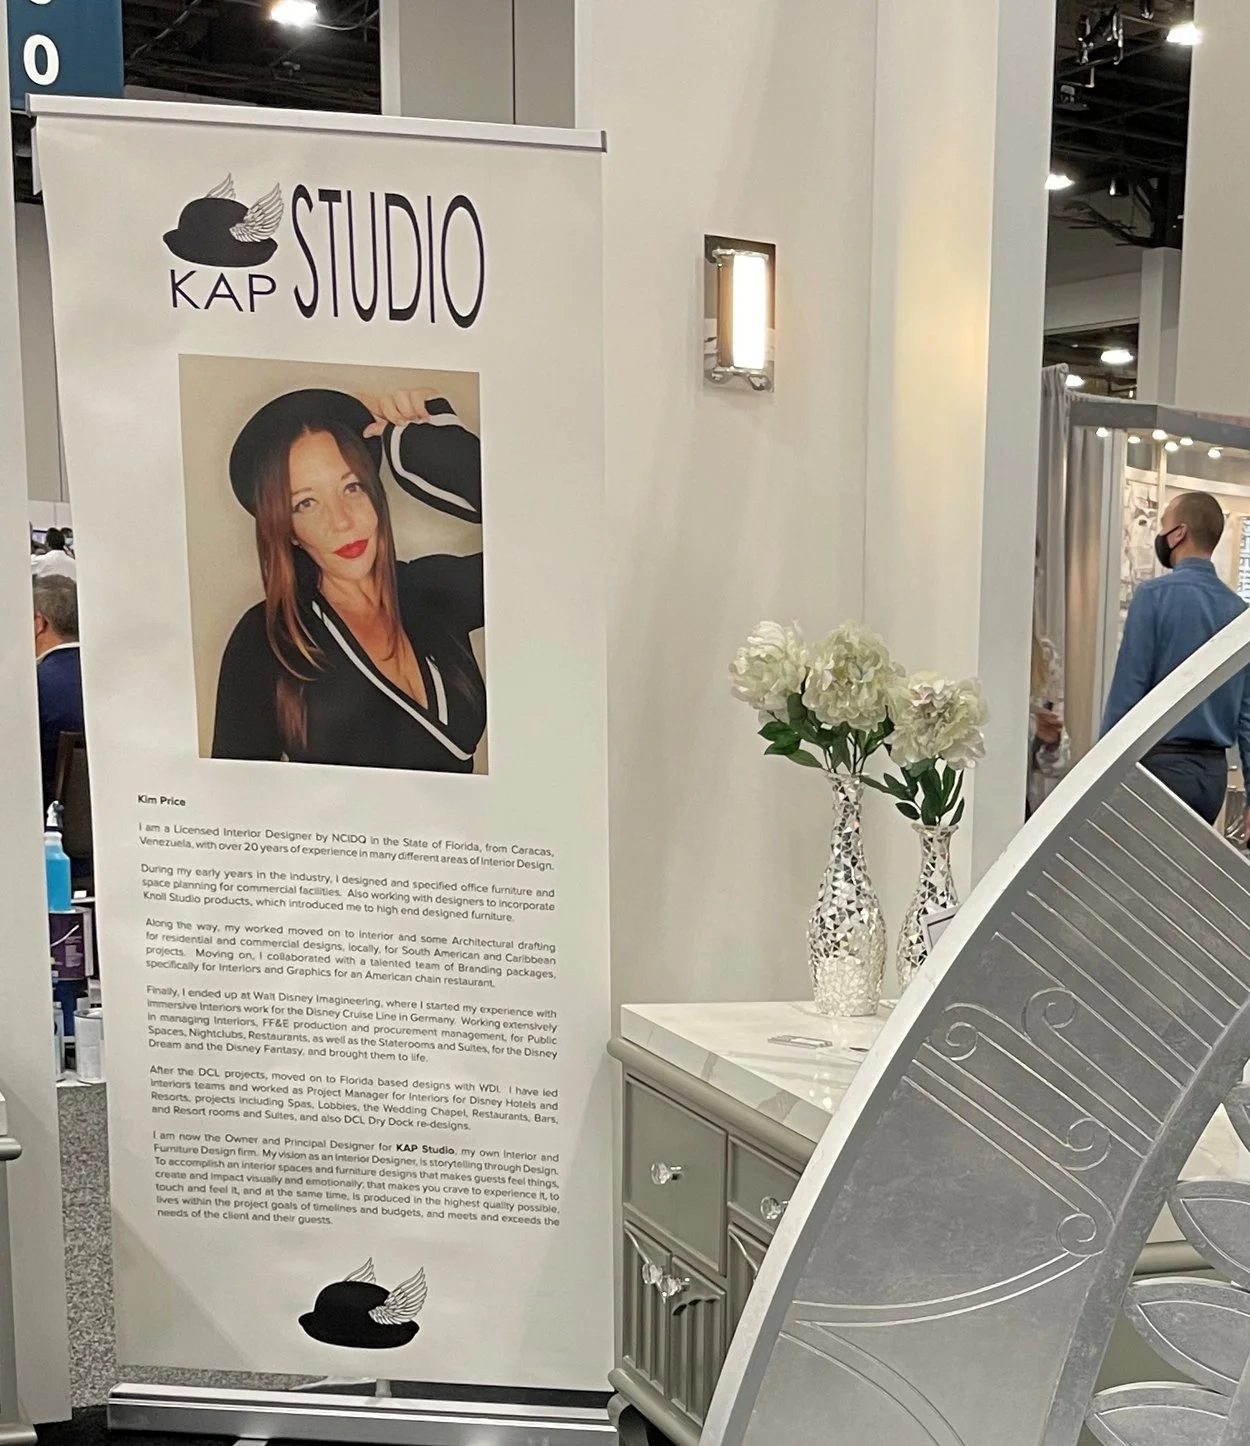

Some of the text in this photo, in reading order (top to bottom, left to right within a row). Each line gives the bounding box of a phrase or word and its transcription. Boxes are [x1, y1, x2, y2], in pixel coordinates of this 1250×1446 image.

[291, 184, 485, 329] STUDIO
[170, 269, 277, 313] KAP
[138, 794, 186, 807] Kim Price
[195, 839, 217, 850] with
[218, 842, 242, 851] over
[369, 851, 397, 863] many
[485, 843, 508, 854] from
[347, 888, 369, 900] Also
[412, 893, 433, 904] with
[376, 904, 399, 917] high
[421, 935, 448, 945] some
[335, 956, 356, 966] with
[415, 960, 440, 971] team
[253, 991, 276, 1002] Walt
[537, 1008, 557, 1019] with
[243, 1004, 269, 1015] work
[376, 1011, 397, 1022] Line
[262, 1018, 289, 1029] FF&E
[325, 1035, 346, 1045] well
[370, 1050, 396, 1061] them
[454, 1083, 475, 1093] with
[515, 1085, 539, 1096] have
[321, 1113, 342, 1124] also
[344, 1114, 366, 1125] DCL
[368, 1115, 386, 1128] Dry
[388, 1116, 414, 1128] Dock
[179, 1134, 201, 1143] now
[396, 1143, 418, 1154] KAP
[479, 1149, 500, 1159] own
[419, 1170, 439, 1181] that
[507, 1175, 526, 1186] feel
[209, 1184, 228, 1195] feel
[296, 1191, 323, 1200] same
[367, 1180, 386, 1191] that
[422, 1185, 441, 1195] you
